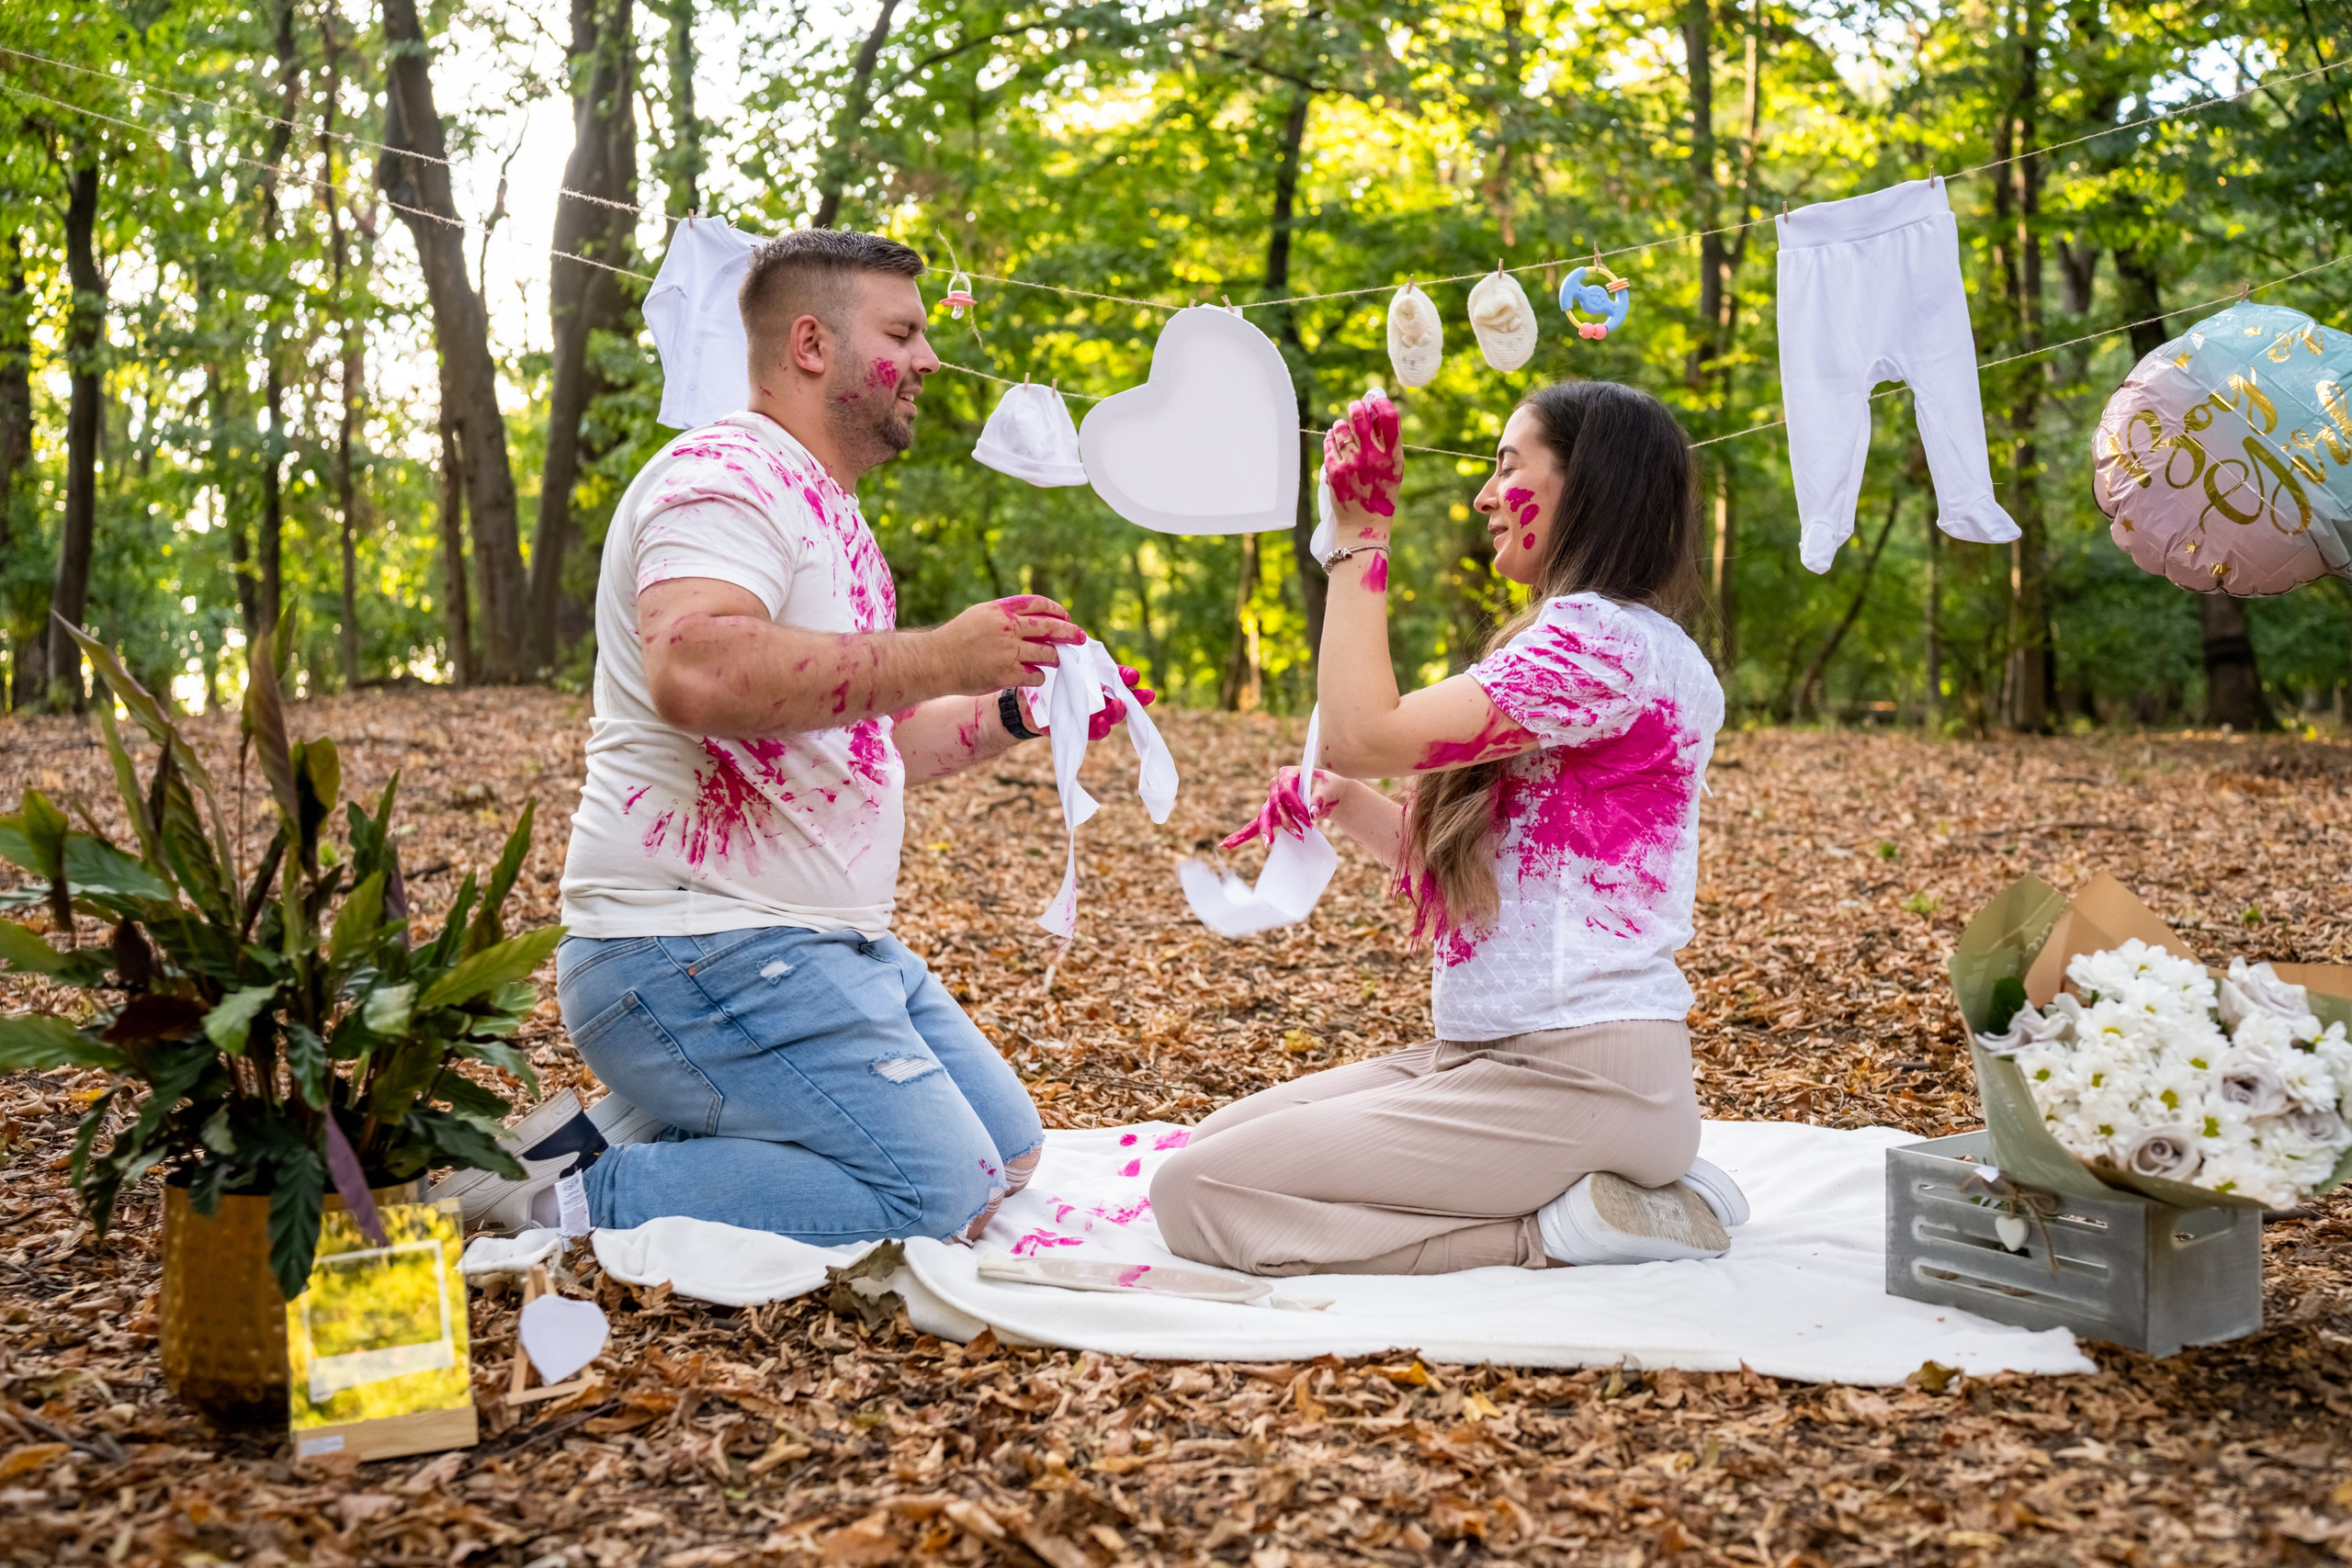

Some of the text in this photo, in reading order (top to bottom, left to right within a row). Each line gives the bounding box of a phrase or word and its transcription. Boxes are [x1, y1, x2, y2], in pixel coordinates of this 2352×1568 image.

[2105, 325, 2324, 498] Boy or
[2199, 379, 2352, 536] Girl
